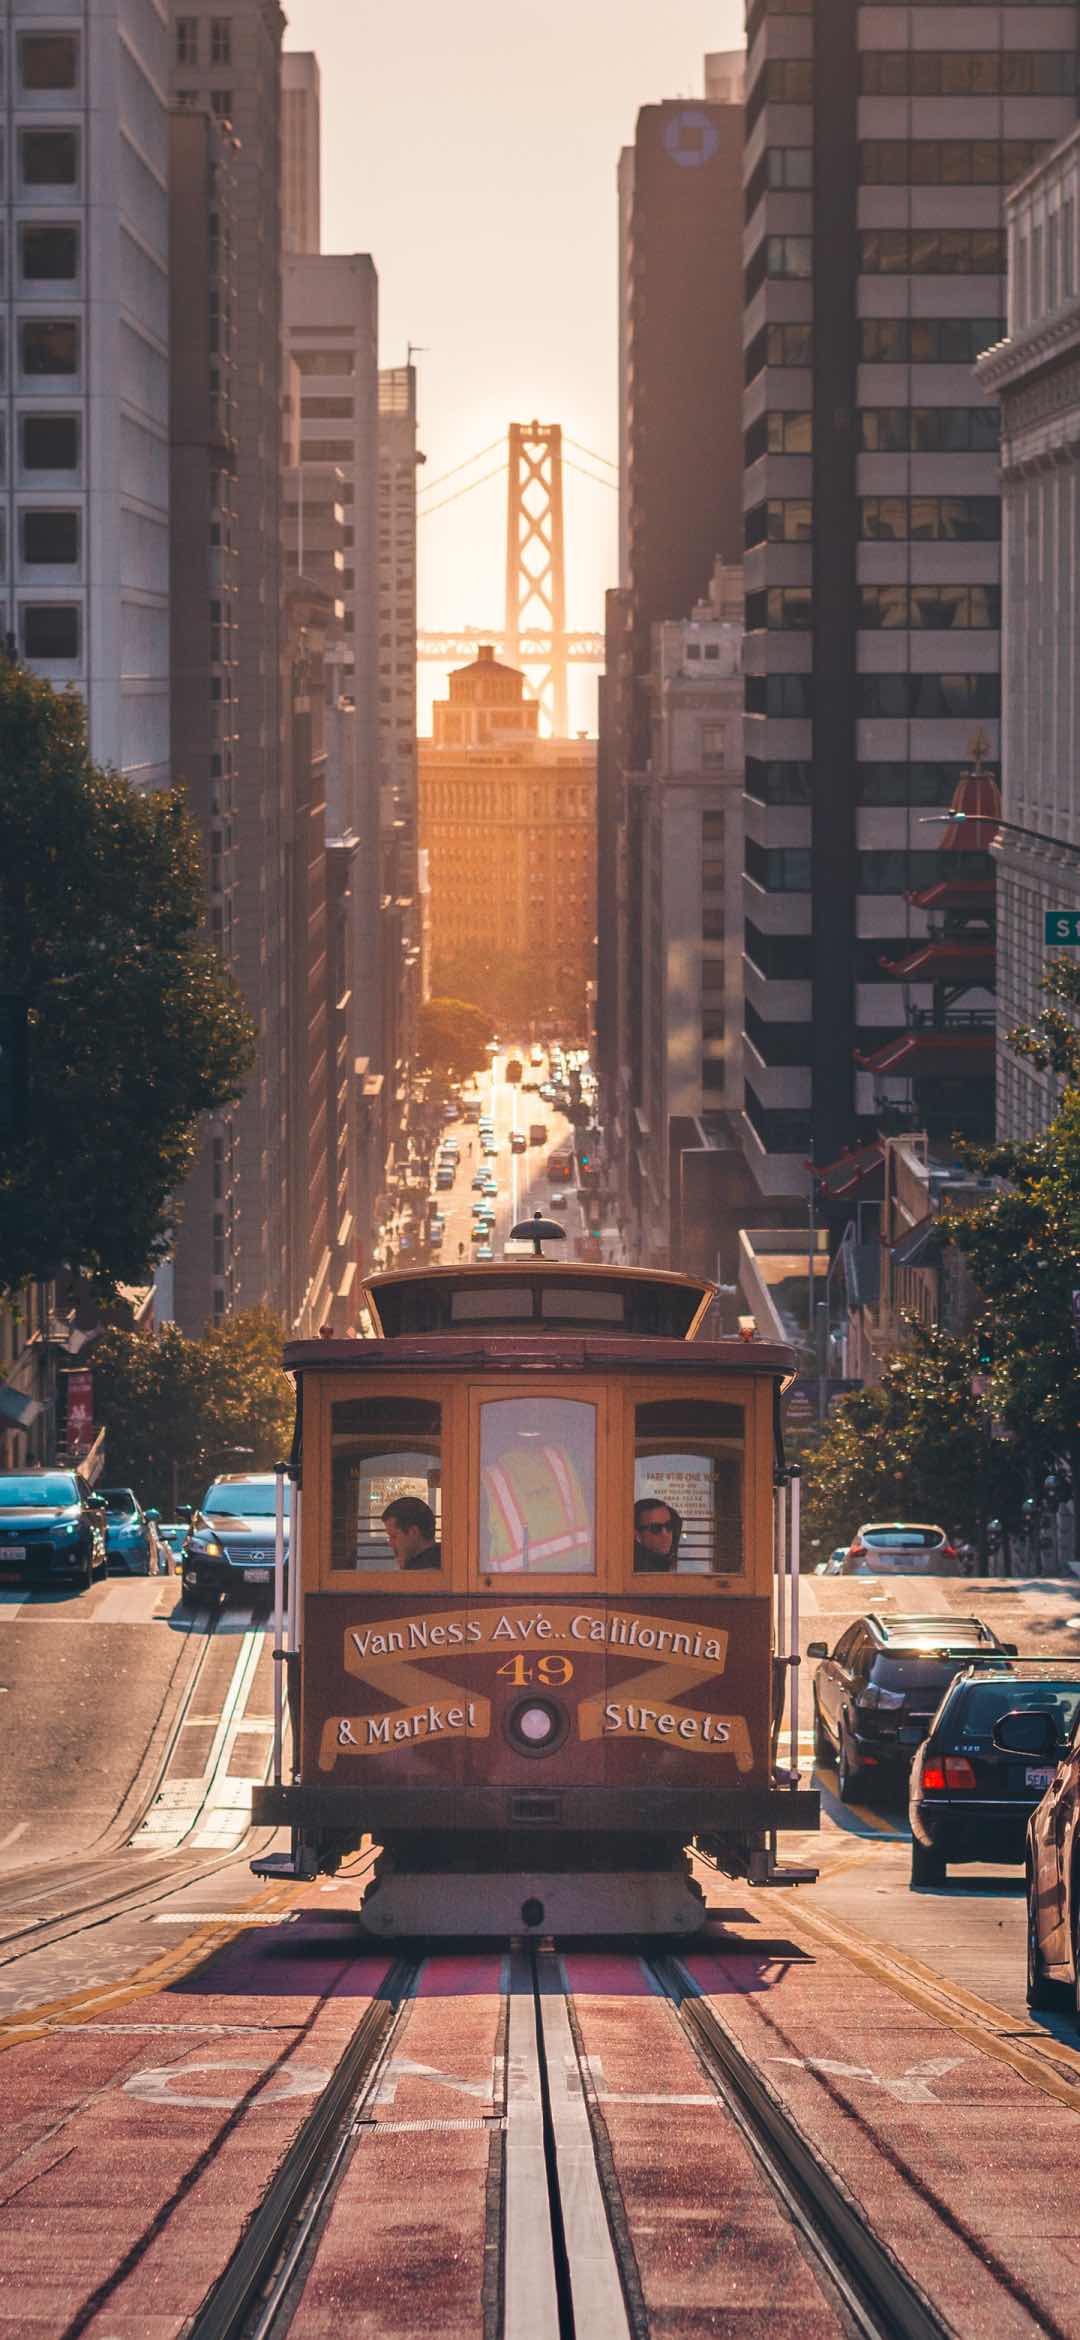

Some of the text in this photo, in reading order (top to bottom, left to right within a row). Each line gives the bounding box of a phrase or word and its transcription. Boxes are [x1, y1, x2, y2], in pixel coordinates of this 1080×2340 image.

[1057, 919, 1080, 937] S
[352, 1629, 404, 1657] Van
[408, 1620, 482, 1649] Ness
[571, 1615, 722, 1662] California
[495, 1653, 574, 1687] 49
[337, 1702, 731, 1746] & Market Streets
